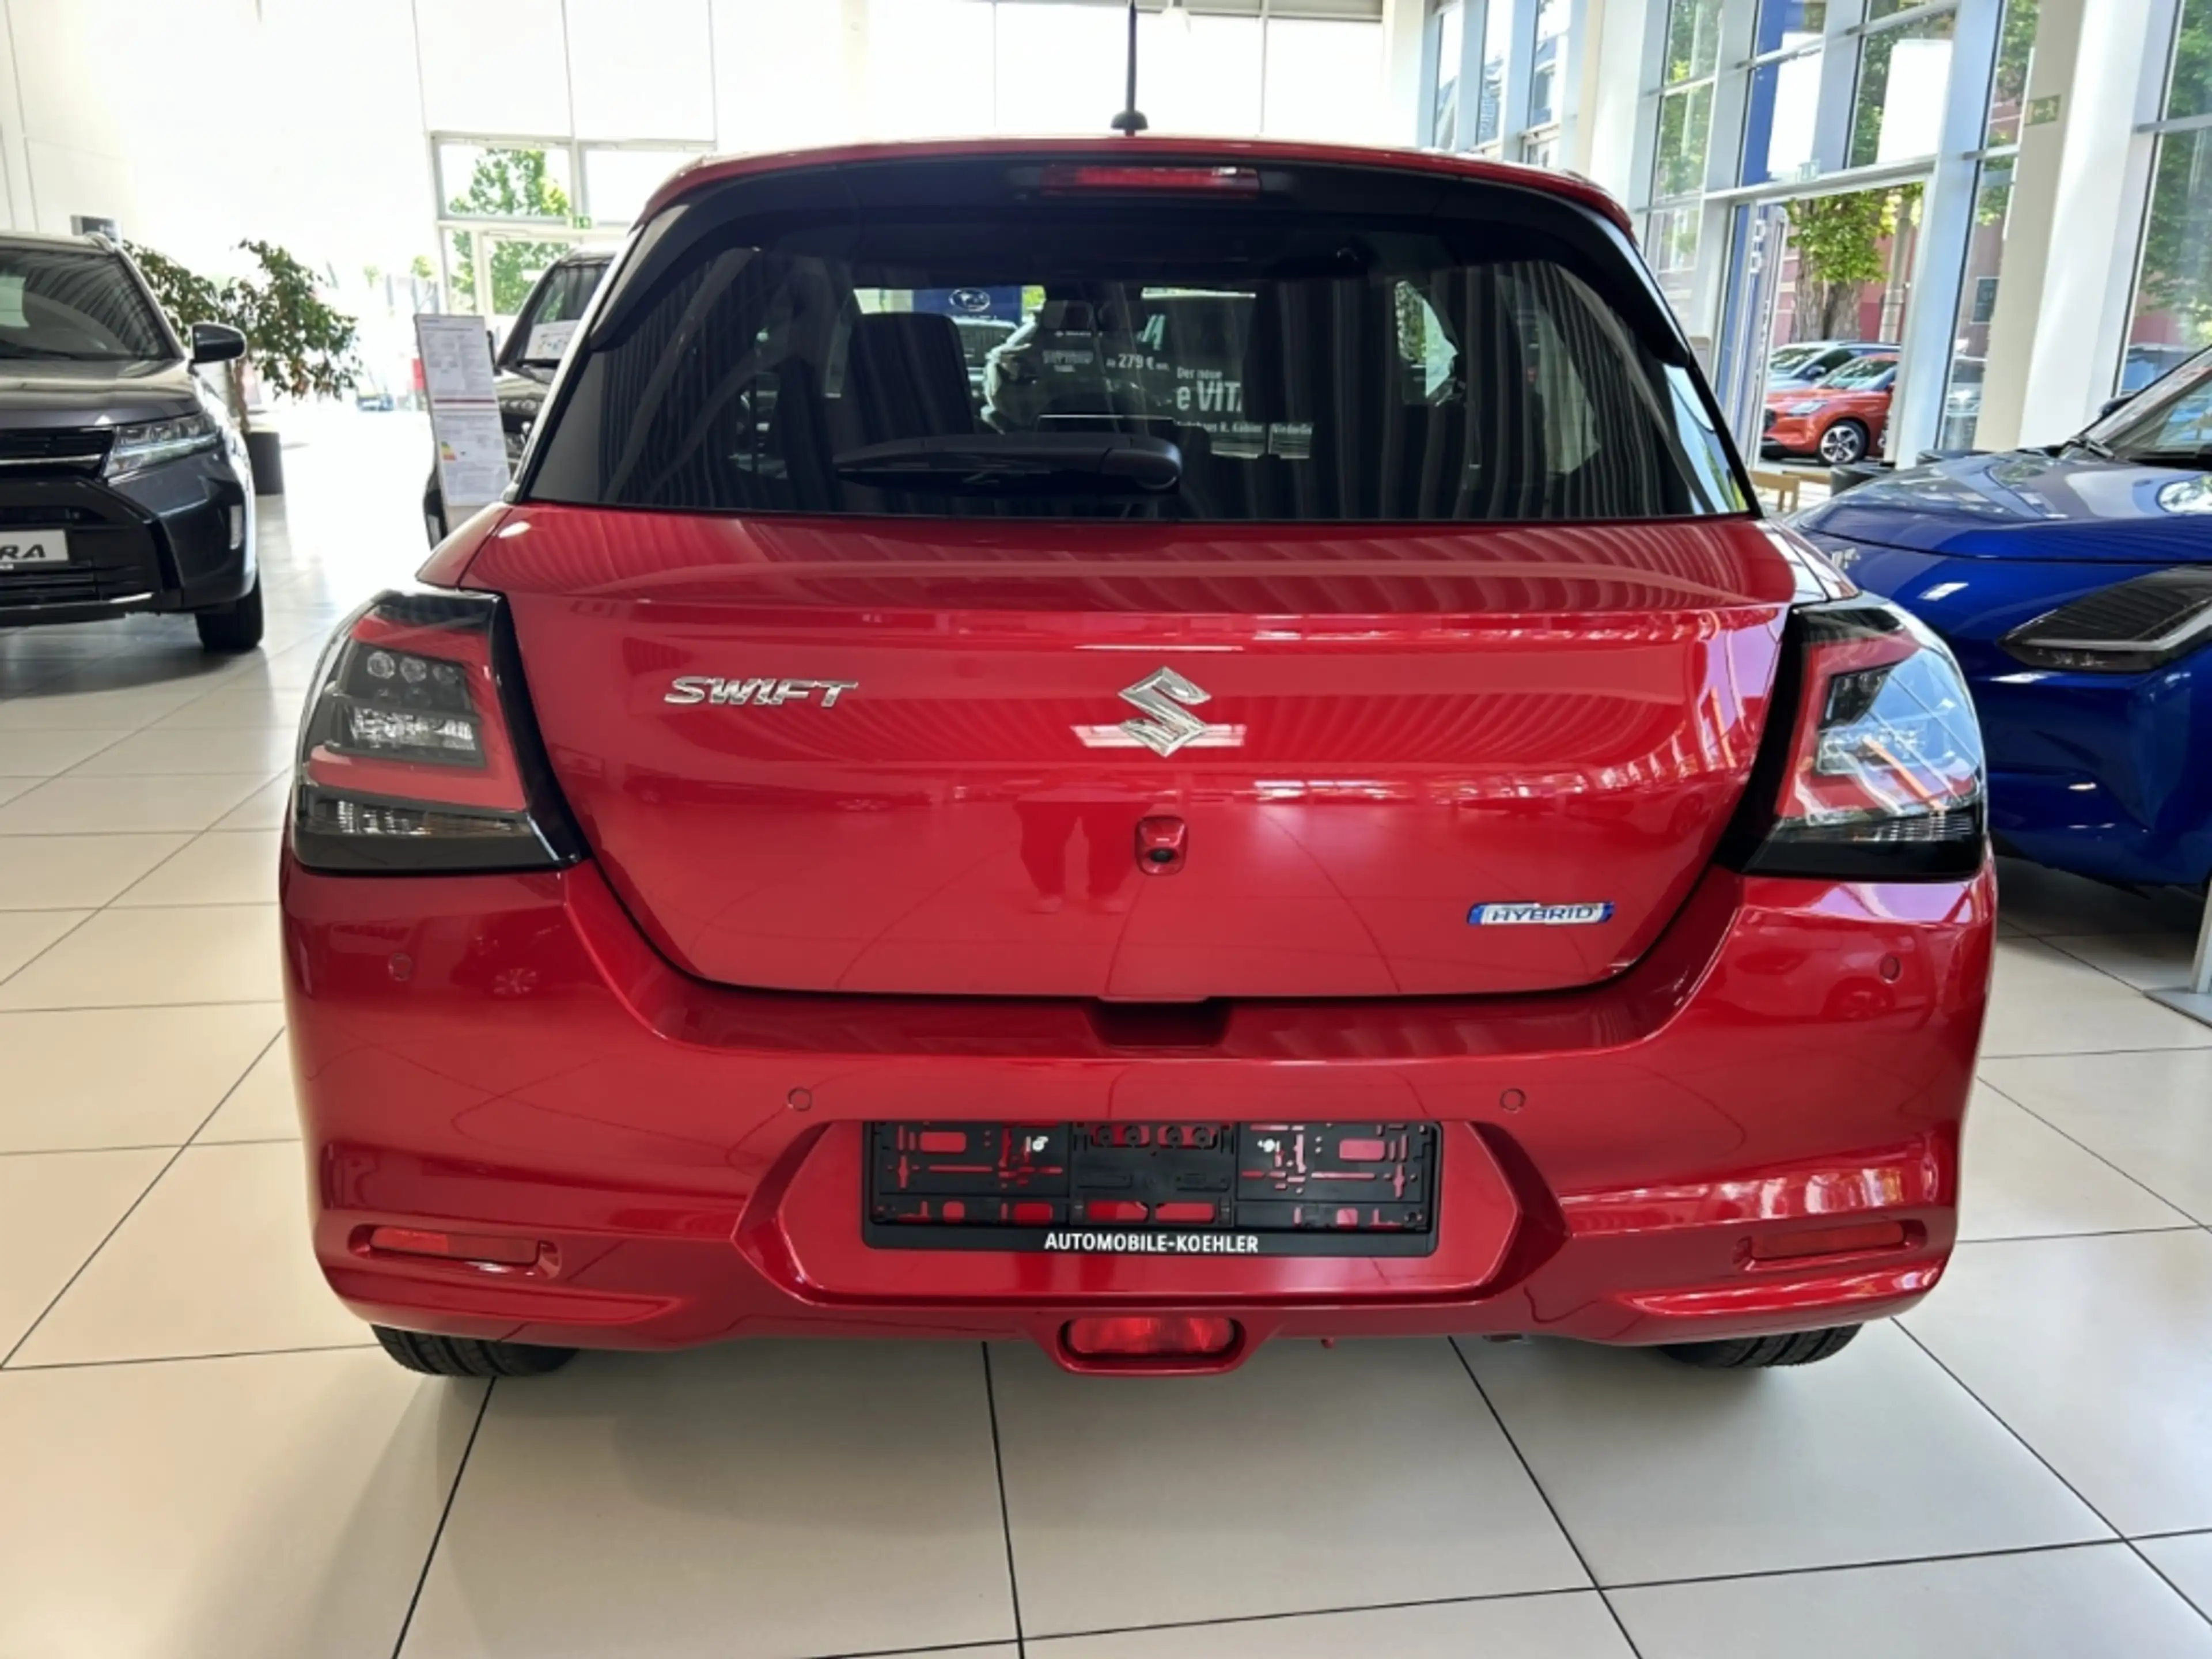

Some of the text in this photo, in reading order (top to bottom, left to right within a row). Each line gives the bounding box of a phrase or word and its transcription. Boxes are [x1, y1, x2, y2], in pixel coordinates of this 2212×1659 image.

[1118, 353, 1144, 369] 279
[1177, 366, 1195, 379] Der
[1196, 369, 1223, 379] neue
[1176, 386, 1191, 411] e
[664, 675, 859, 708] SWIFT
[1491, 906, 1594, 921] HYBRID
[1044, 1232, 1259, 1253] AUTOMOBILE-KOEHLER
